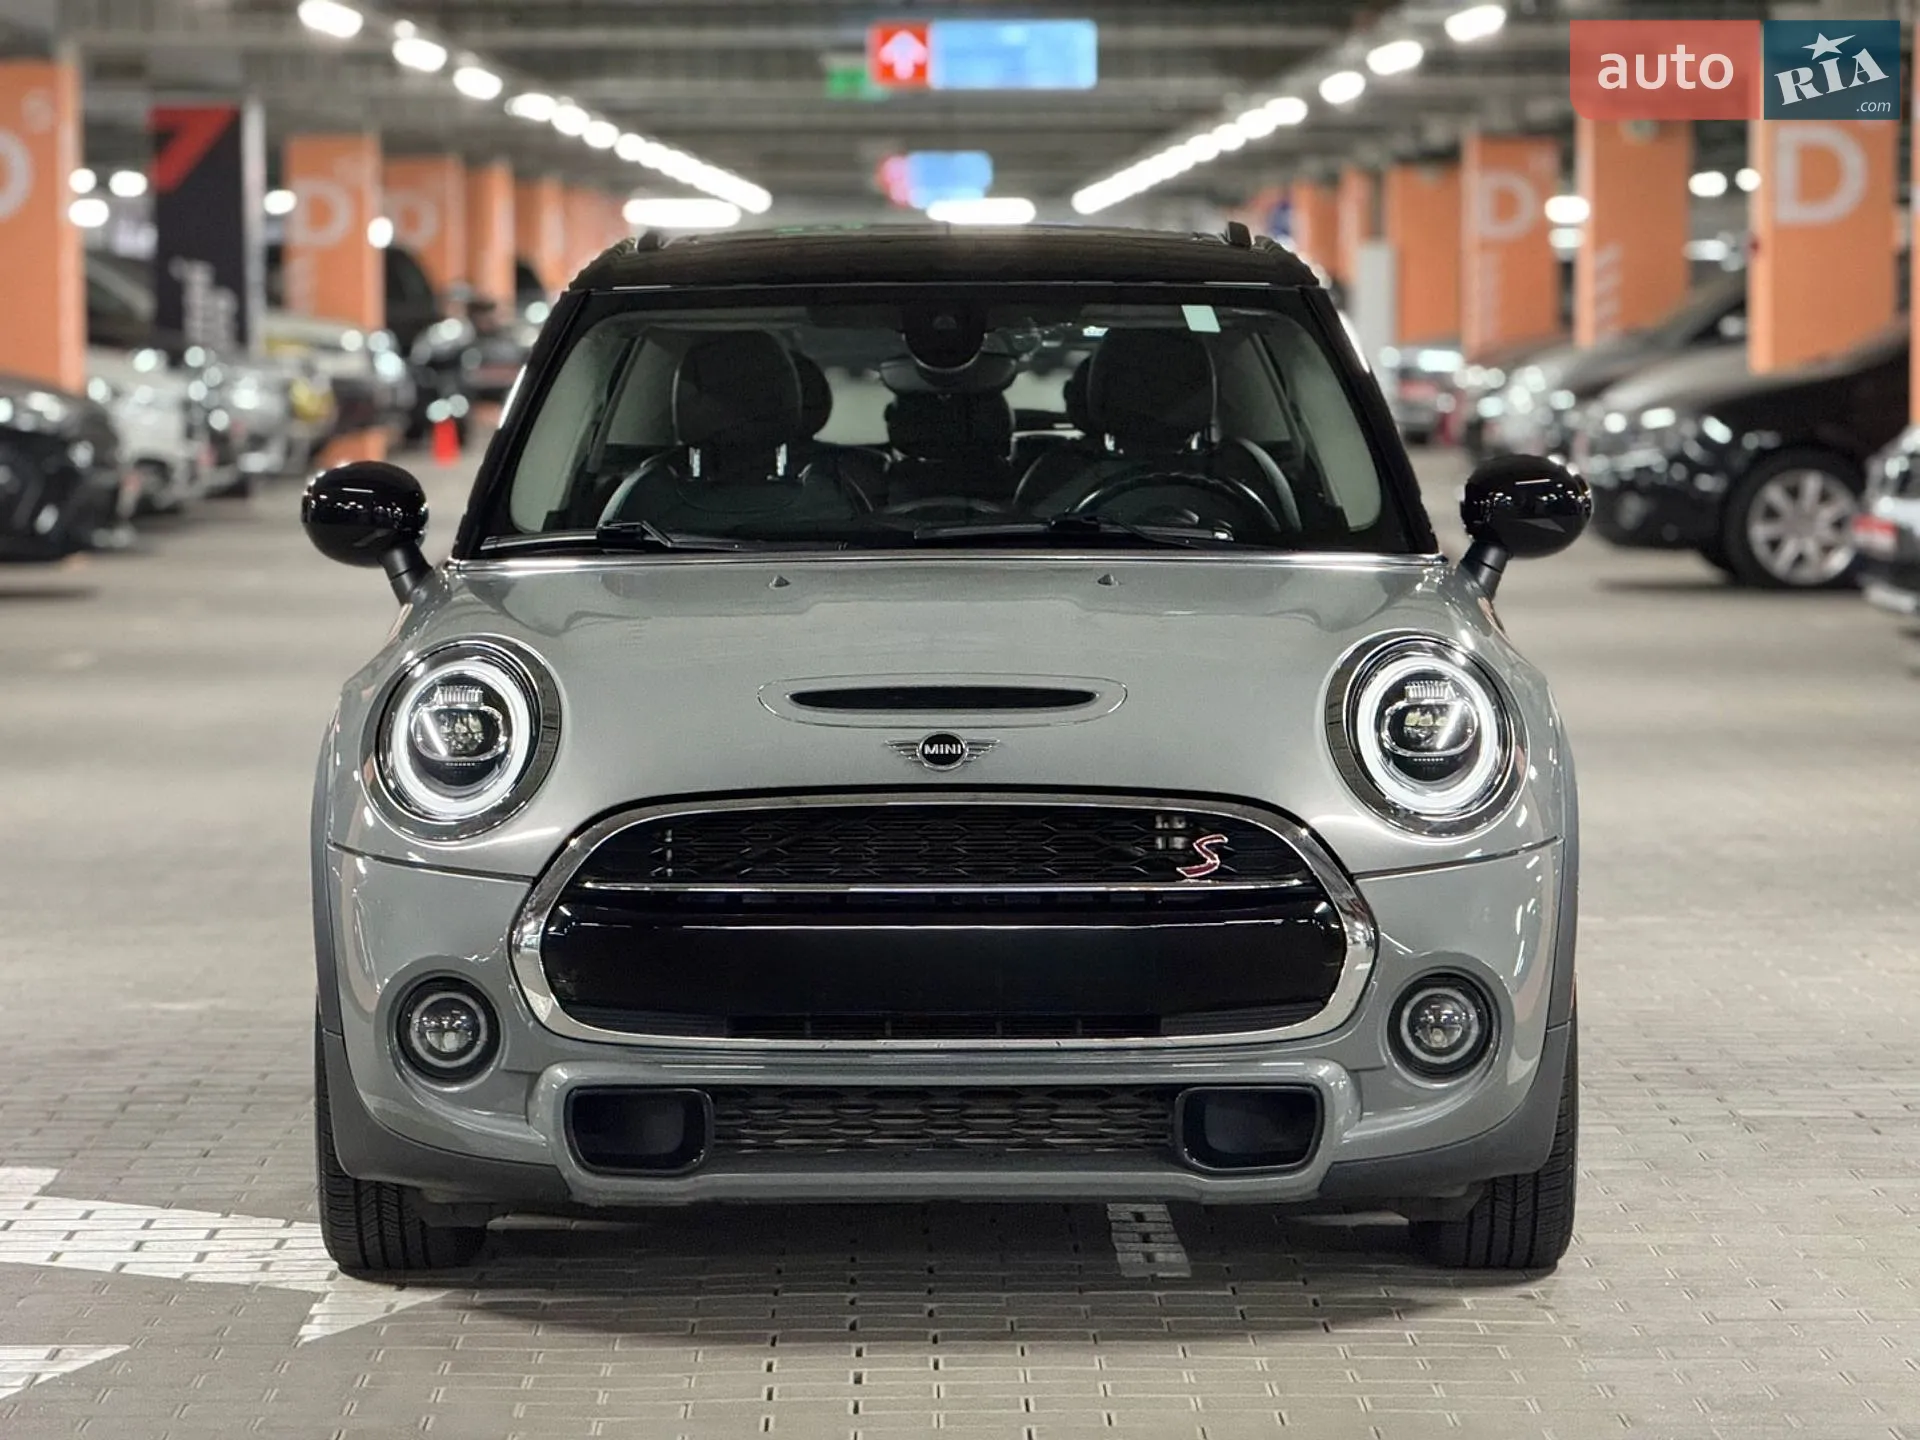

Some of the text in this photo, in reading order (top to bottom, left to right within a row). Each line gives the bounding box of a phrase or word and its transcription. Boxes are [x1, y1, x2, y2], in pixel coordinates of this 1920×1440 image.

[1774, 124, 1869, 227] D
[923, 743, 962, 756] MINI
[1176, 833, 1229, 878] S
